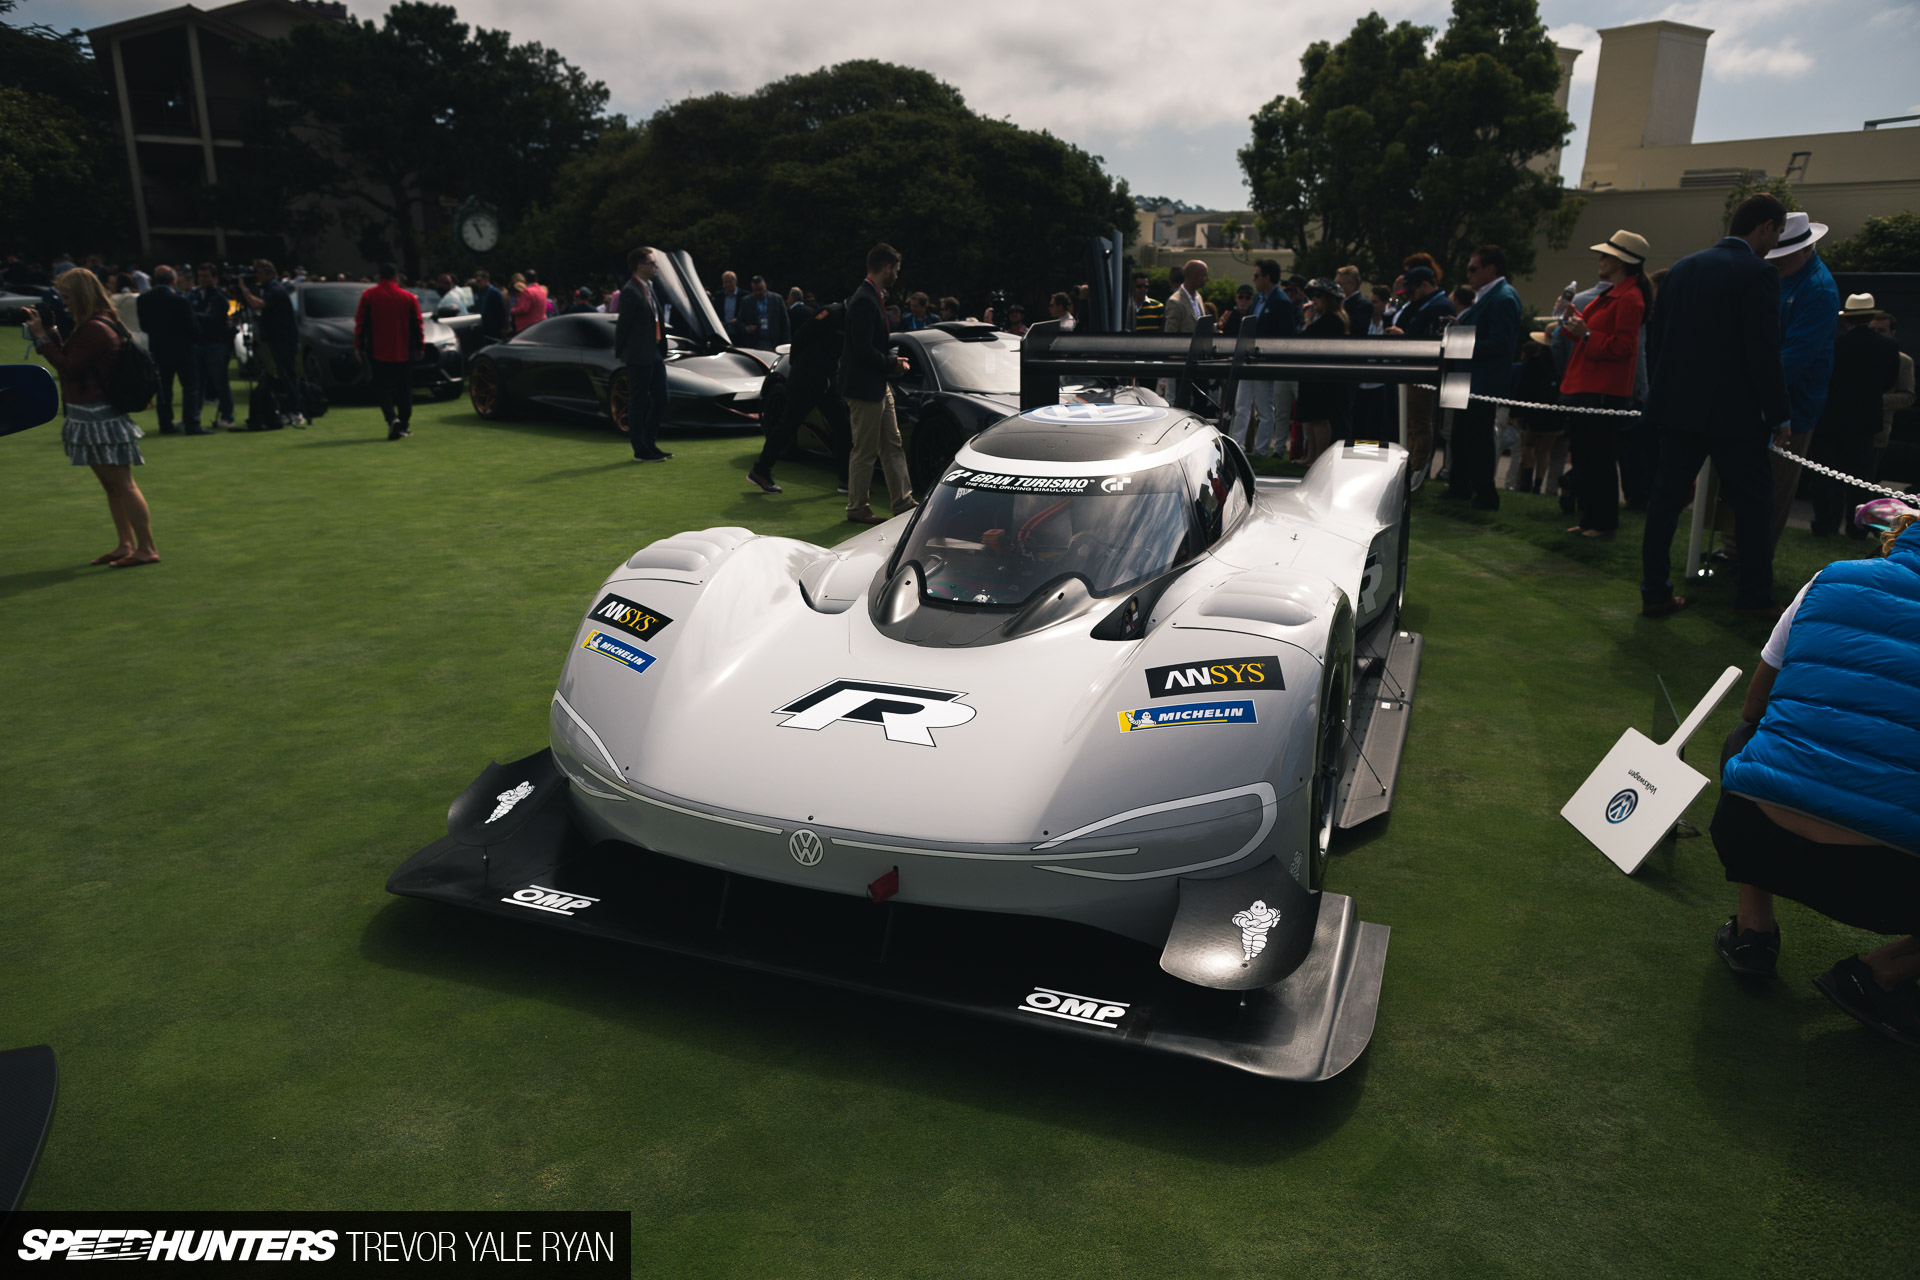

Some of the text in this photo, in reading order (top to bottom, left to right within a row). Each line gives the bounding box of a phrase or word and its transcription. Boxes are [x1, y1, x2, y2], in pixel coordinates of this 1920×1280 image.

[969, 473, 1089, 489] GRAN TURISMO
[597, 600, 656, 632] ANSYS
[599, 641, 646, 666] MICHELIN
[1164, 663, 1265, 690] ANSYS
[771, 677, 977, 747] R
[1158, 707, 1244, 722] MICHELIN
[1628, 769, 1657, 795] Volkswagen
[513, 888, 592, 911] OMP
[1025, 992, 1126, 1022] OMP
